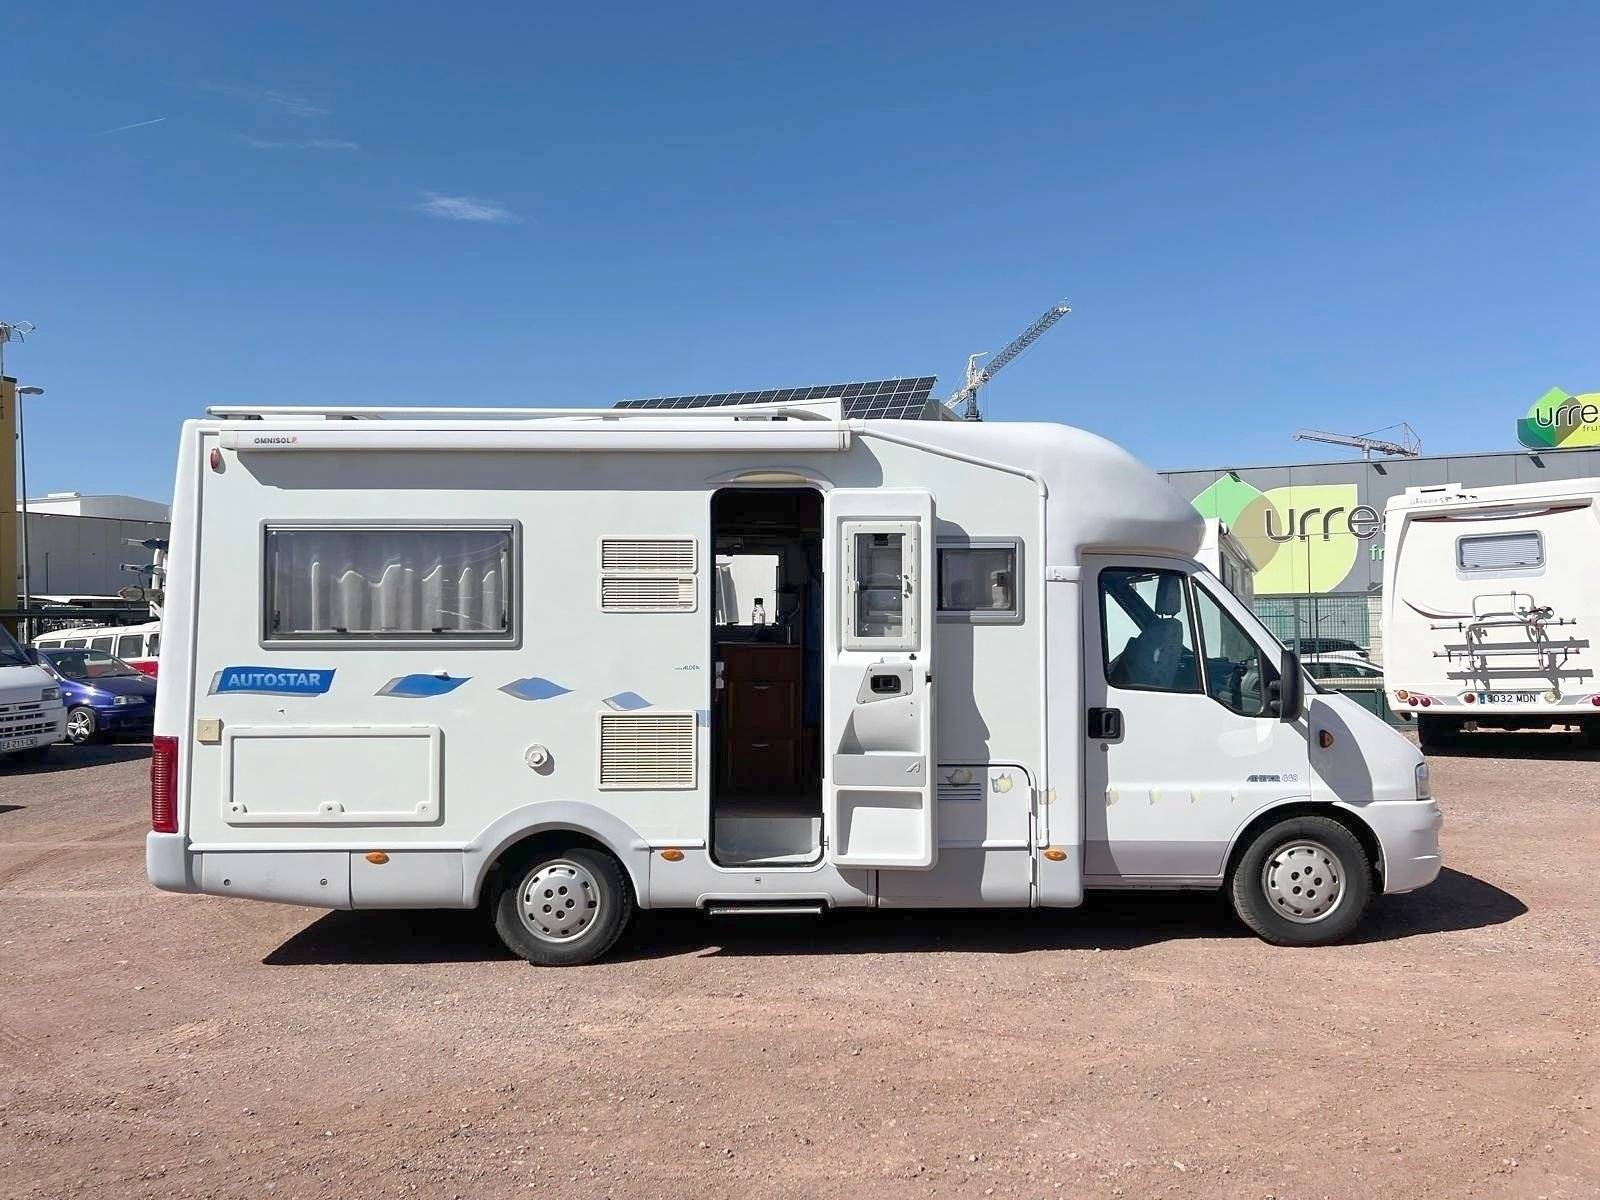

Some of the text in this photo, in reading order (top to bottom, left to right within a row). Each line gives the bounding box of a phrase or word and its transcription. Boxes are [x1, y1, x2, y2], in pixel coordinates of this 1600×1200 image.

[1265, 506, 1385, 542] urre
[228, 673, 320, 687] AUTOSTAR
[1487, 694, 1536, 703] 3032 MDN
